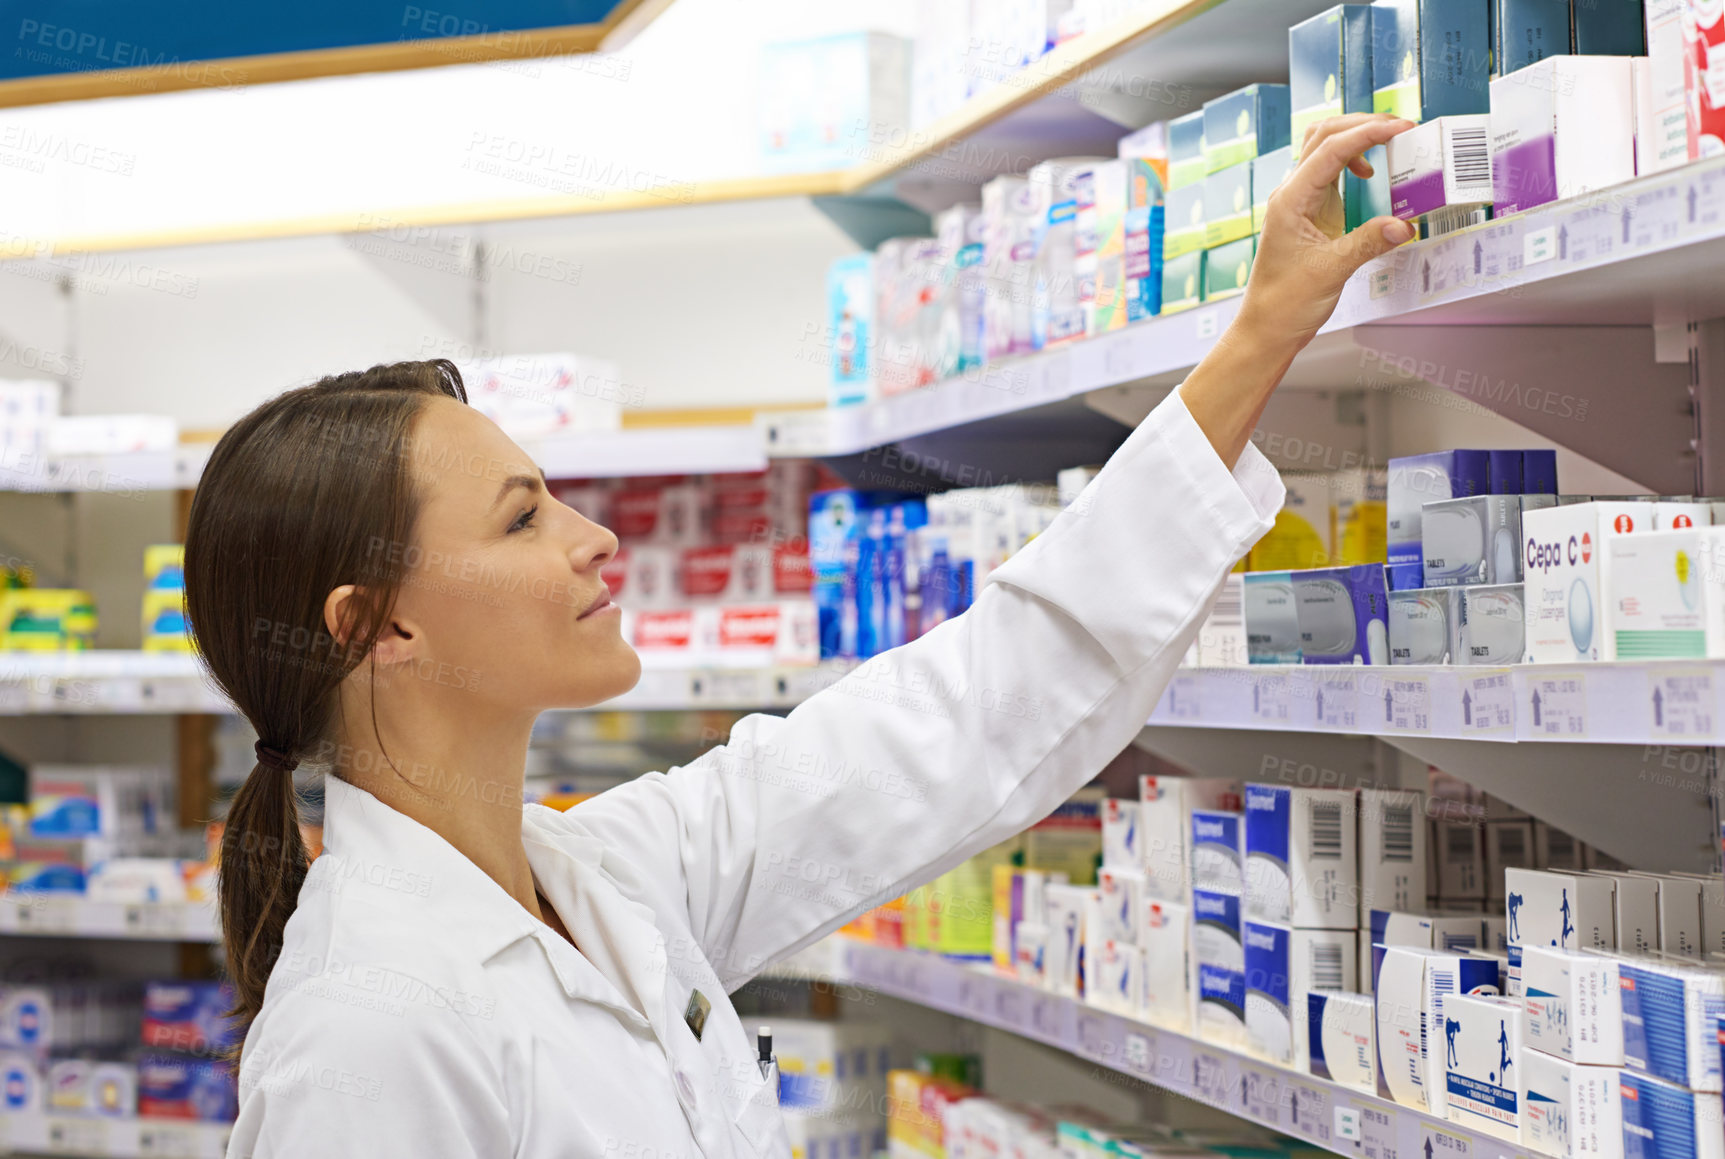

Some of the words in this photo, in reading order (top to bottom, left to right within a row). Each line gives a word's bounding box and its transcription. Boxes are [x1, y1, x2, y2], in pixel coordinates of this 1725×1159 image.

[1527, 537, 1561, 574] Cepa
[1567, 535, 1577, 566] C
[1426, 558, 1445, 569] TABLETS
[1393, 648, 1411, 658] TABLETS
[1471, 646, 1489, 657] TABLETS
